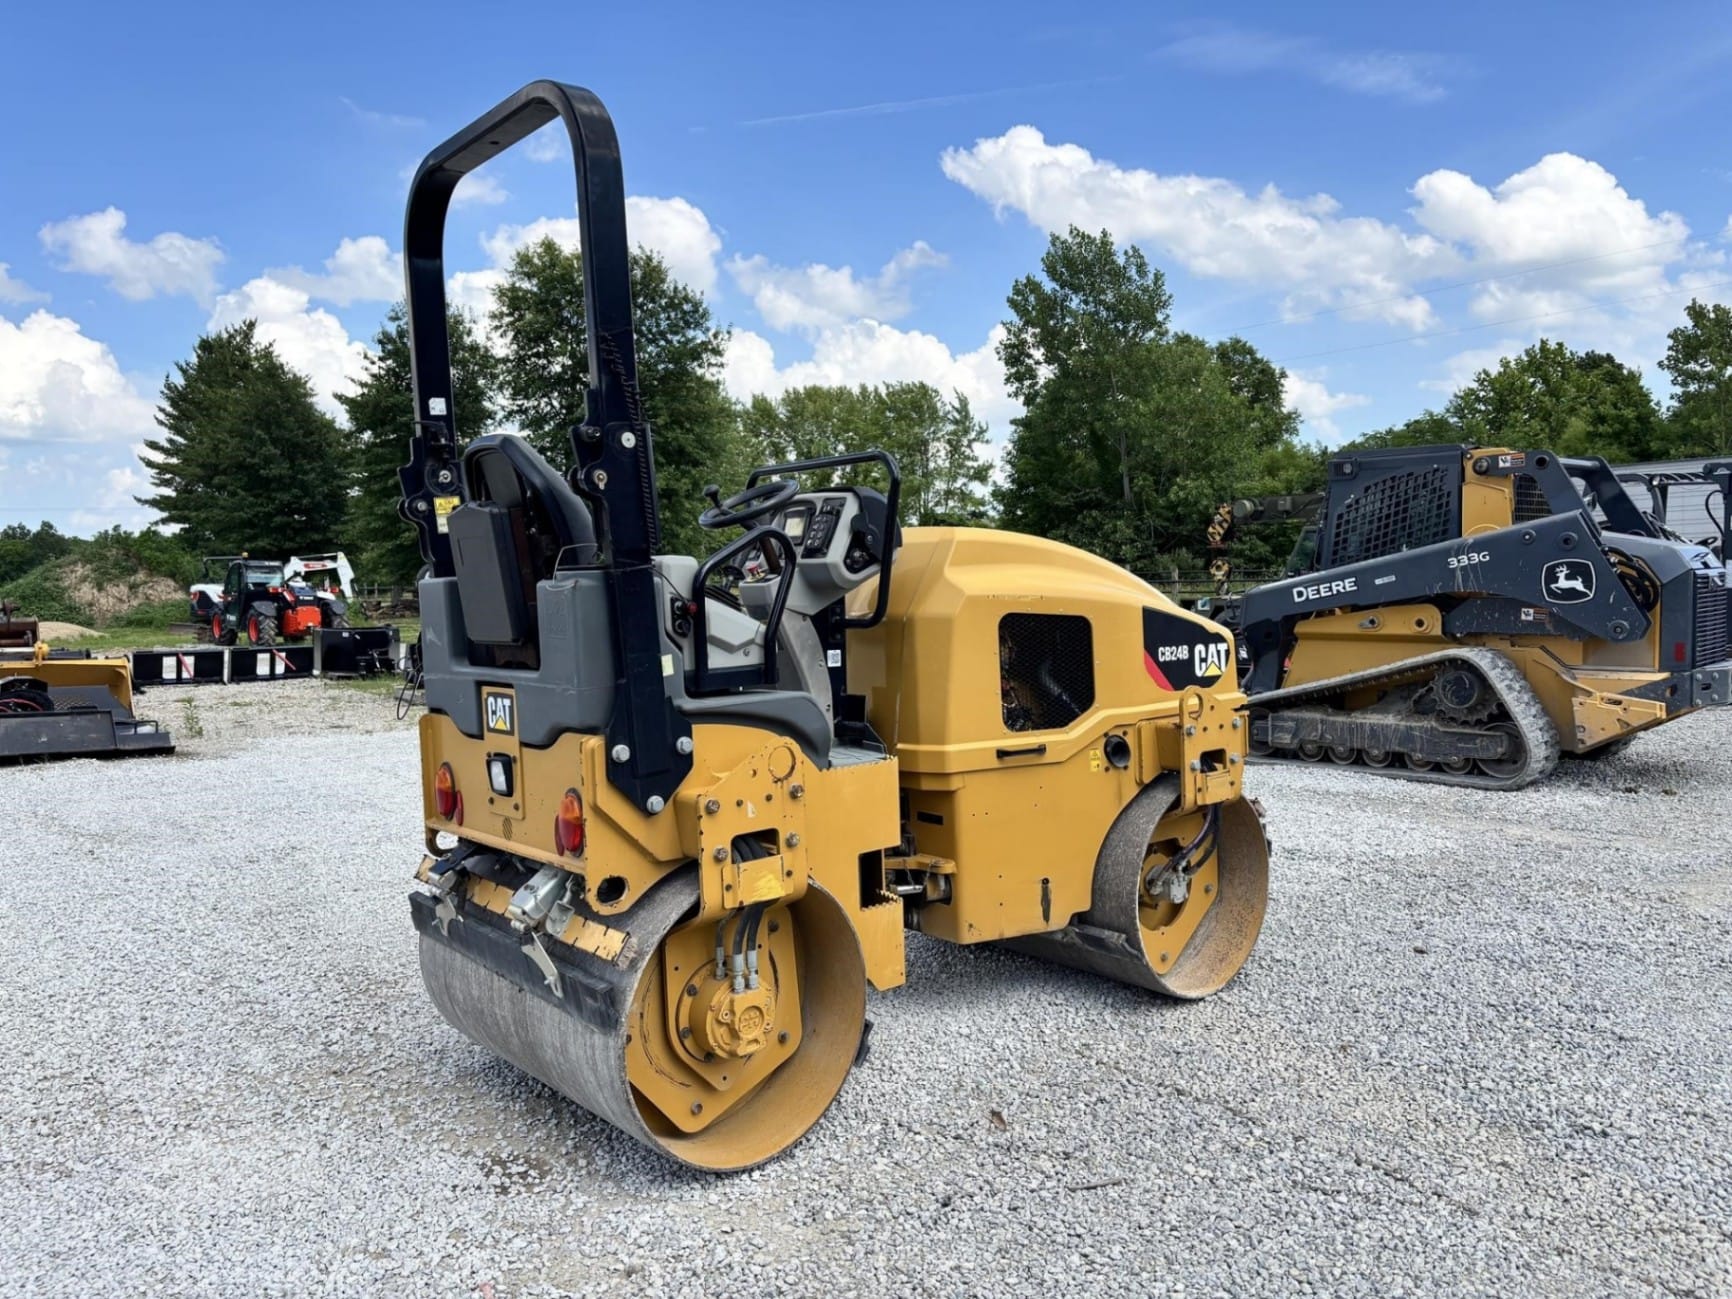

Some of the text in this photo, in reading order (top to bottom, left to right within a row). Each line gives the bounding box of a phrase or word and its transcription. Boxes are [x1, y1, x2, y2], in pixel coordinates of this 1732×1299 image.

[1448, 551, 1490, 568] 333G
[1292, 577, 1357, 603] DEERE
[1158, 644, 1189, 662] CB24B
[1194, 642, 1228, 677] CAT
[487, 695, 511, 731] CAT
